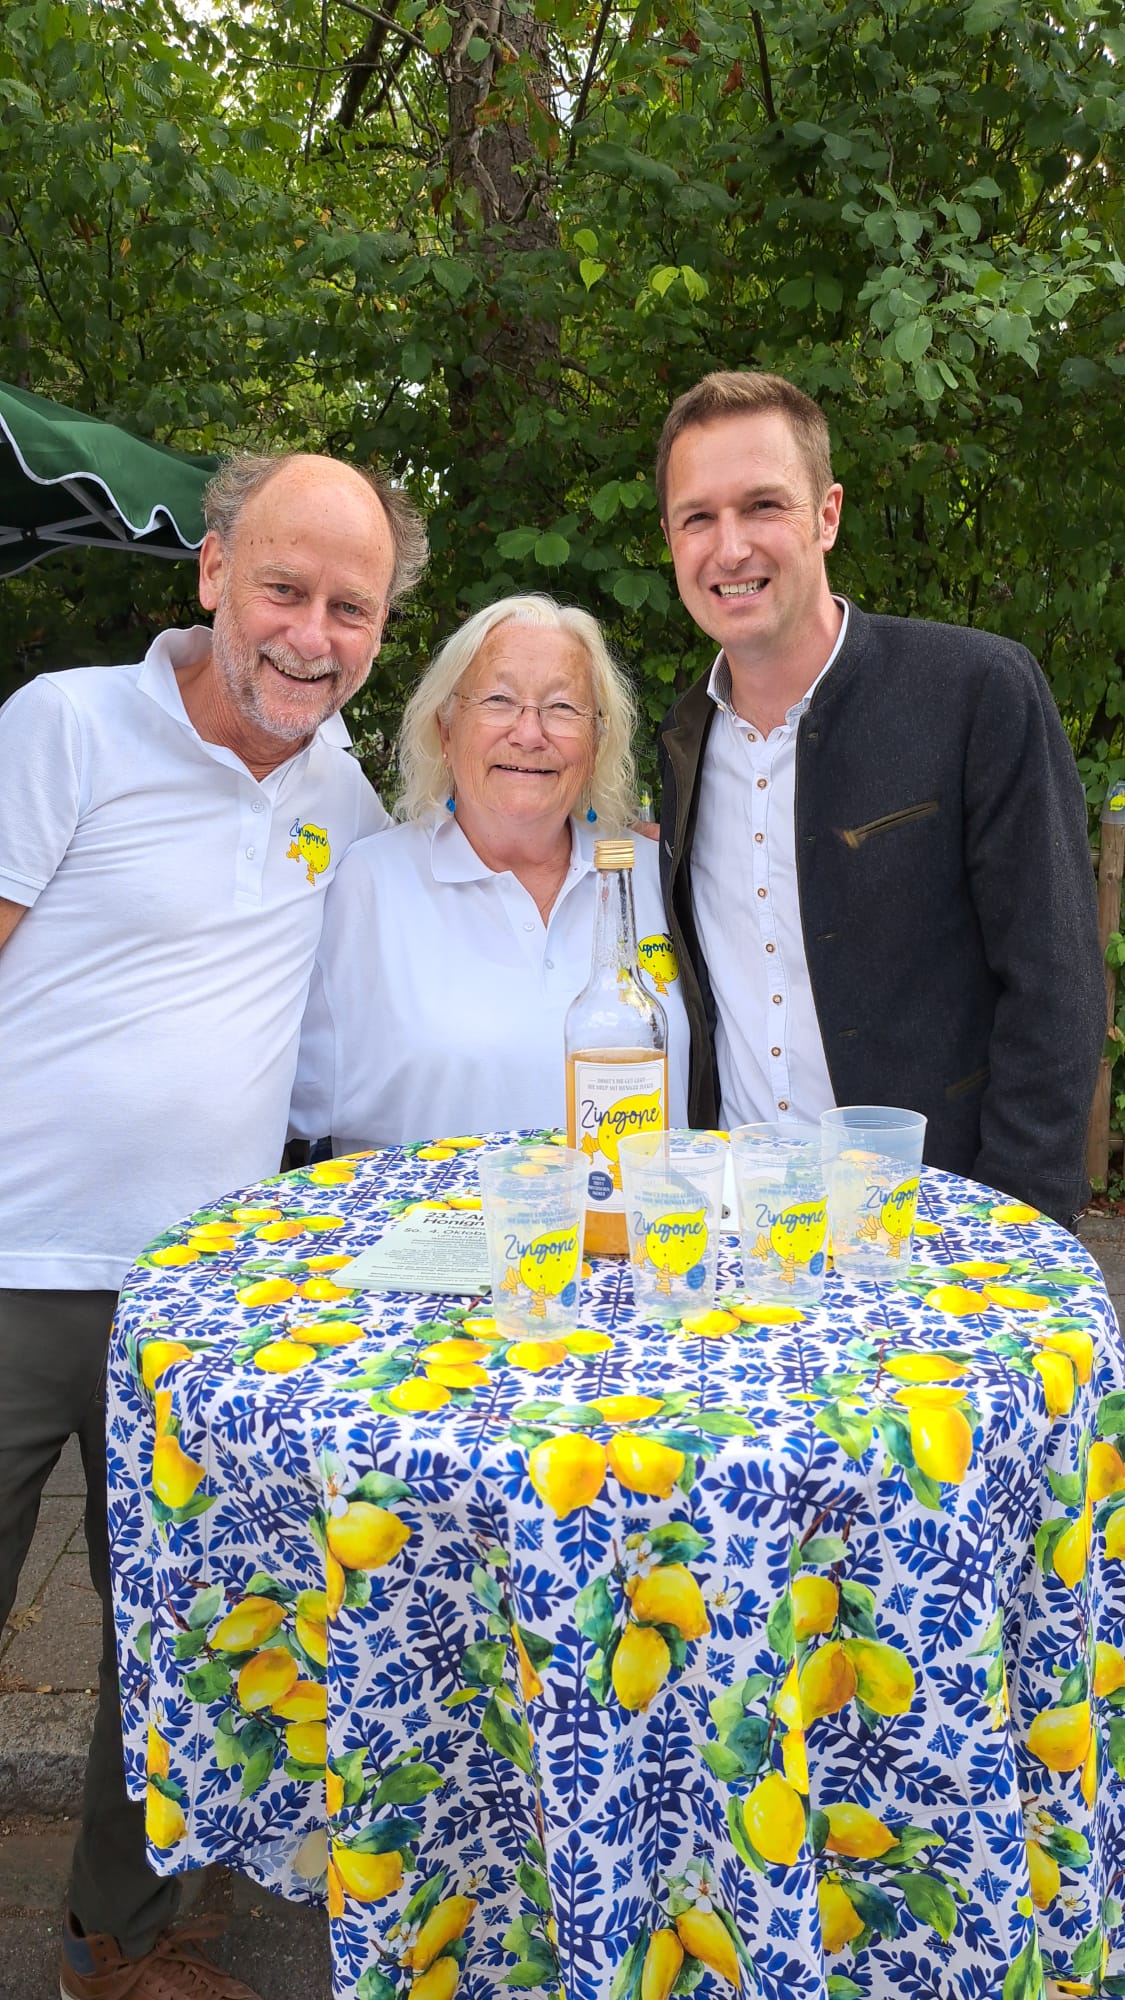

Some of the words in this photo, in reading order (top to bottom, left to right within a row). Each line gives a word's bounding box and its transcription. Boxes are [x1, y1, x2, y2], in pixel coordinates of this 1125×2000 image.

[289, 817, 328, 848] Zingone
[581, 1099, 660, 1135] Zingone
[633, 1210, 704, 1243] Zingone
[755, 1203, 826, 1233] Zingone
[504, 1234, 577, 1264] Zingone
